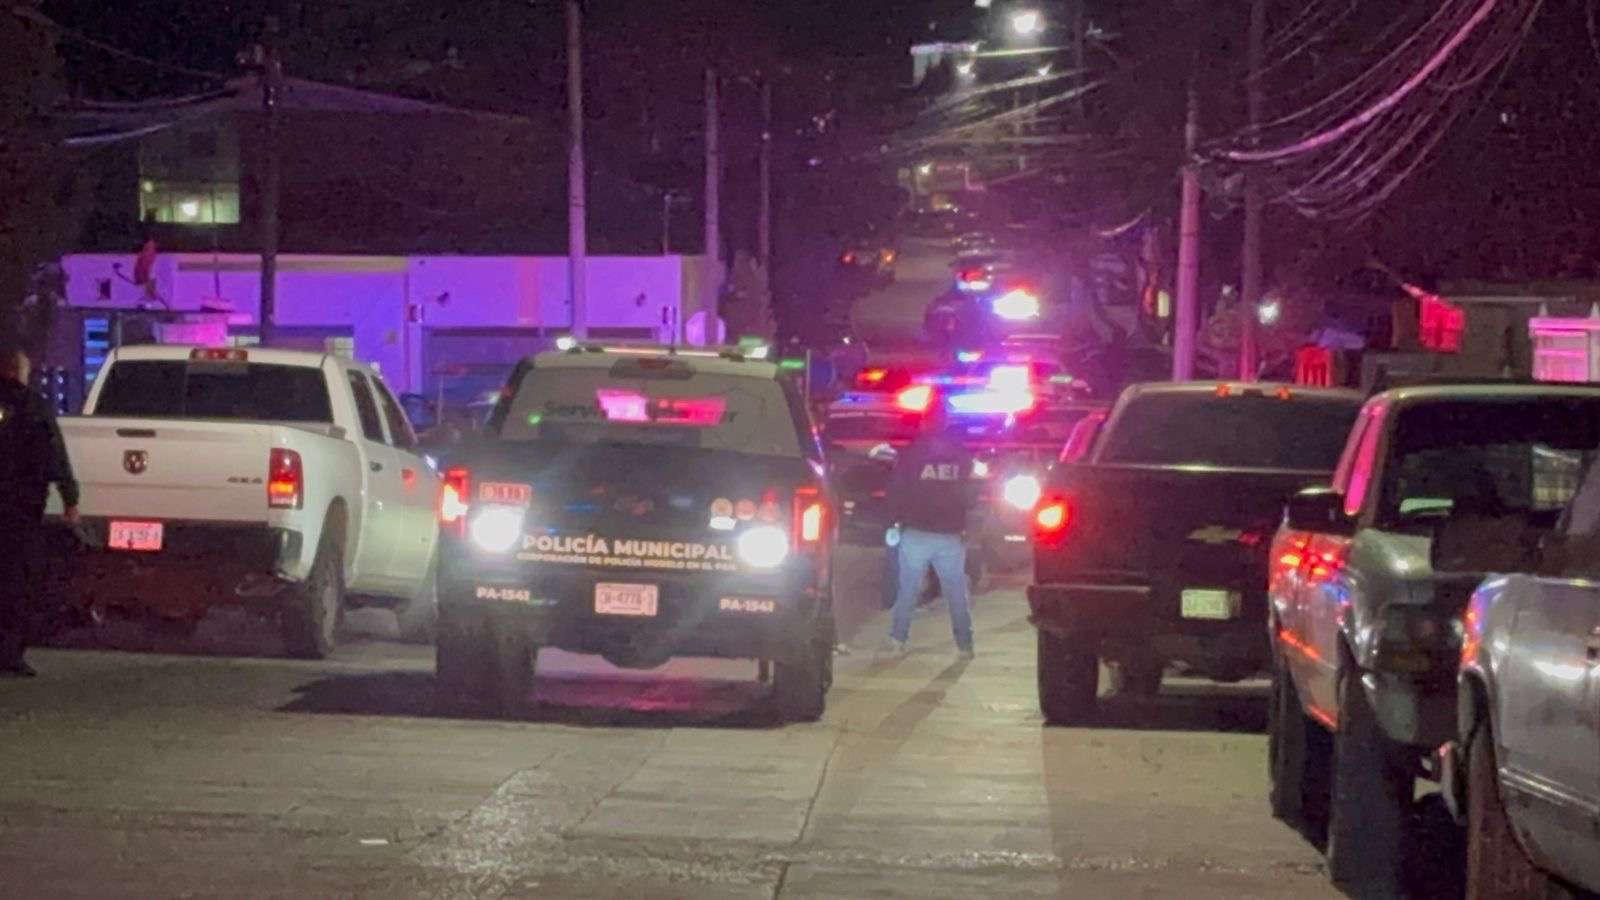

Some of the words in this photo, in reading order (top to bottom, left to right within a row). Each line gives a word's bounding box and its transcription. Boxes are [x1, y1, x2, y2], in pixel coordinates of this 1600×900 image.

[920, 463, 961, 480] AEI
[523, 533, 609, 554] POLICÍA
[613, 539, 734, 561] MUNICIPAL
